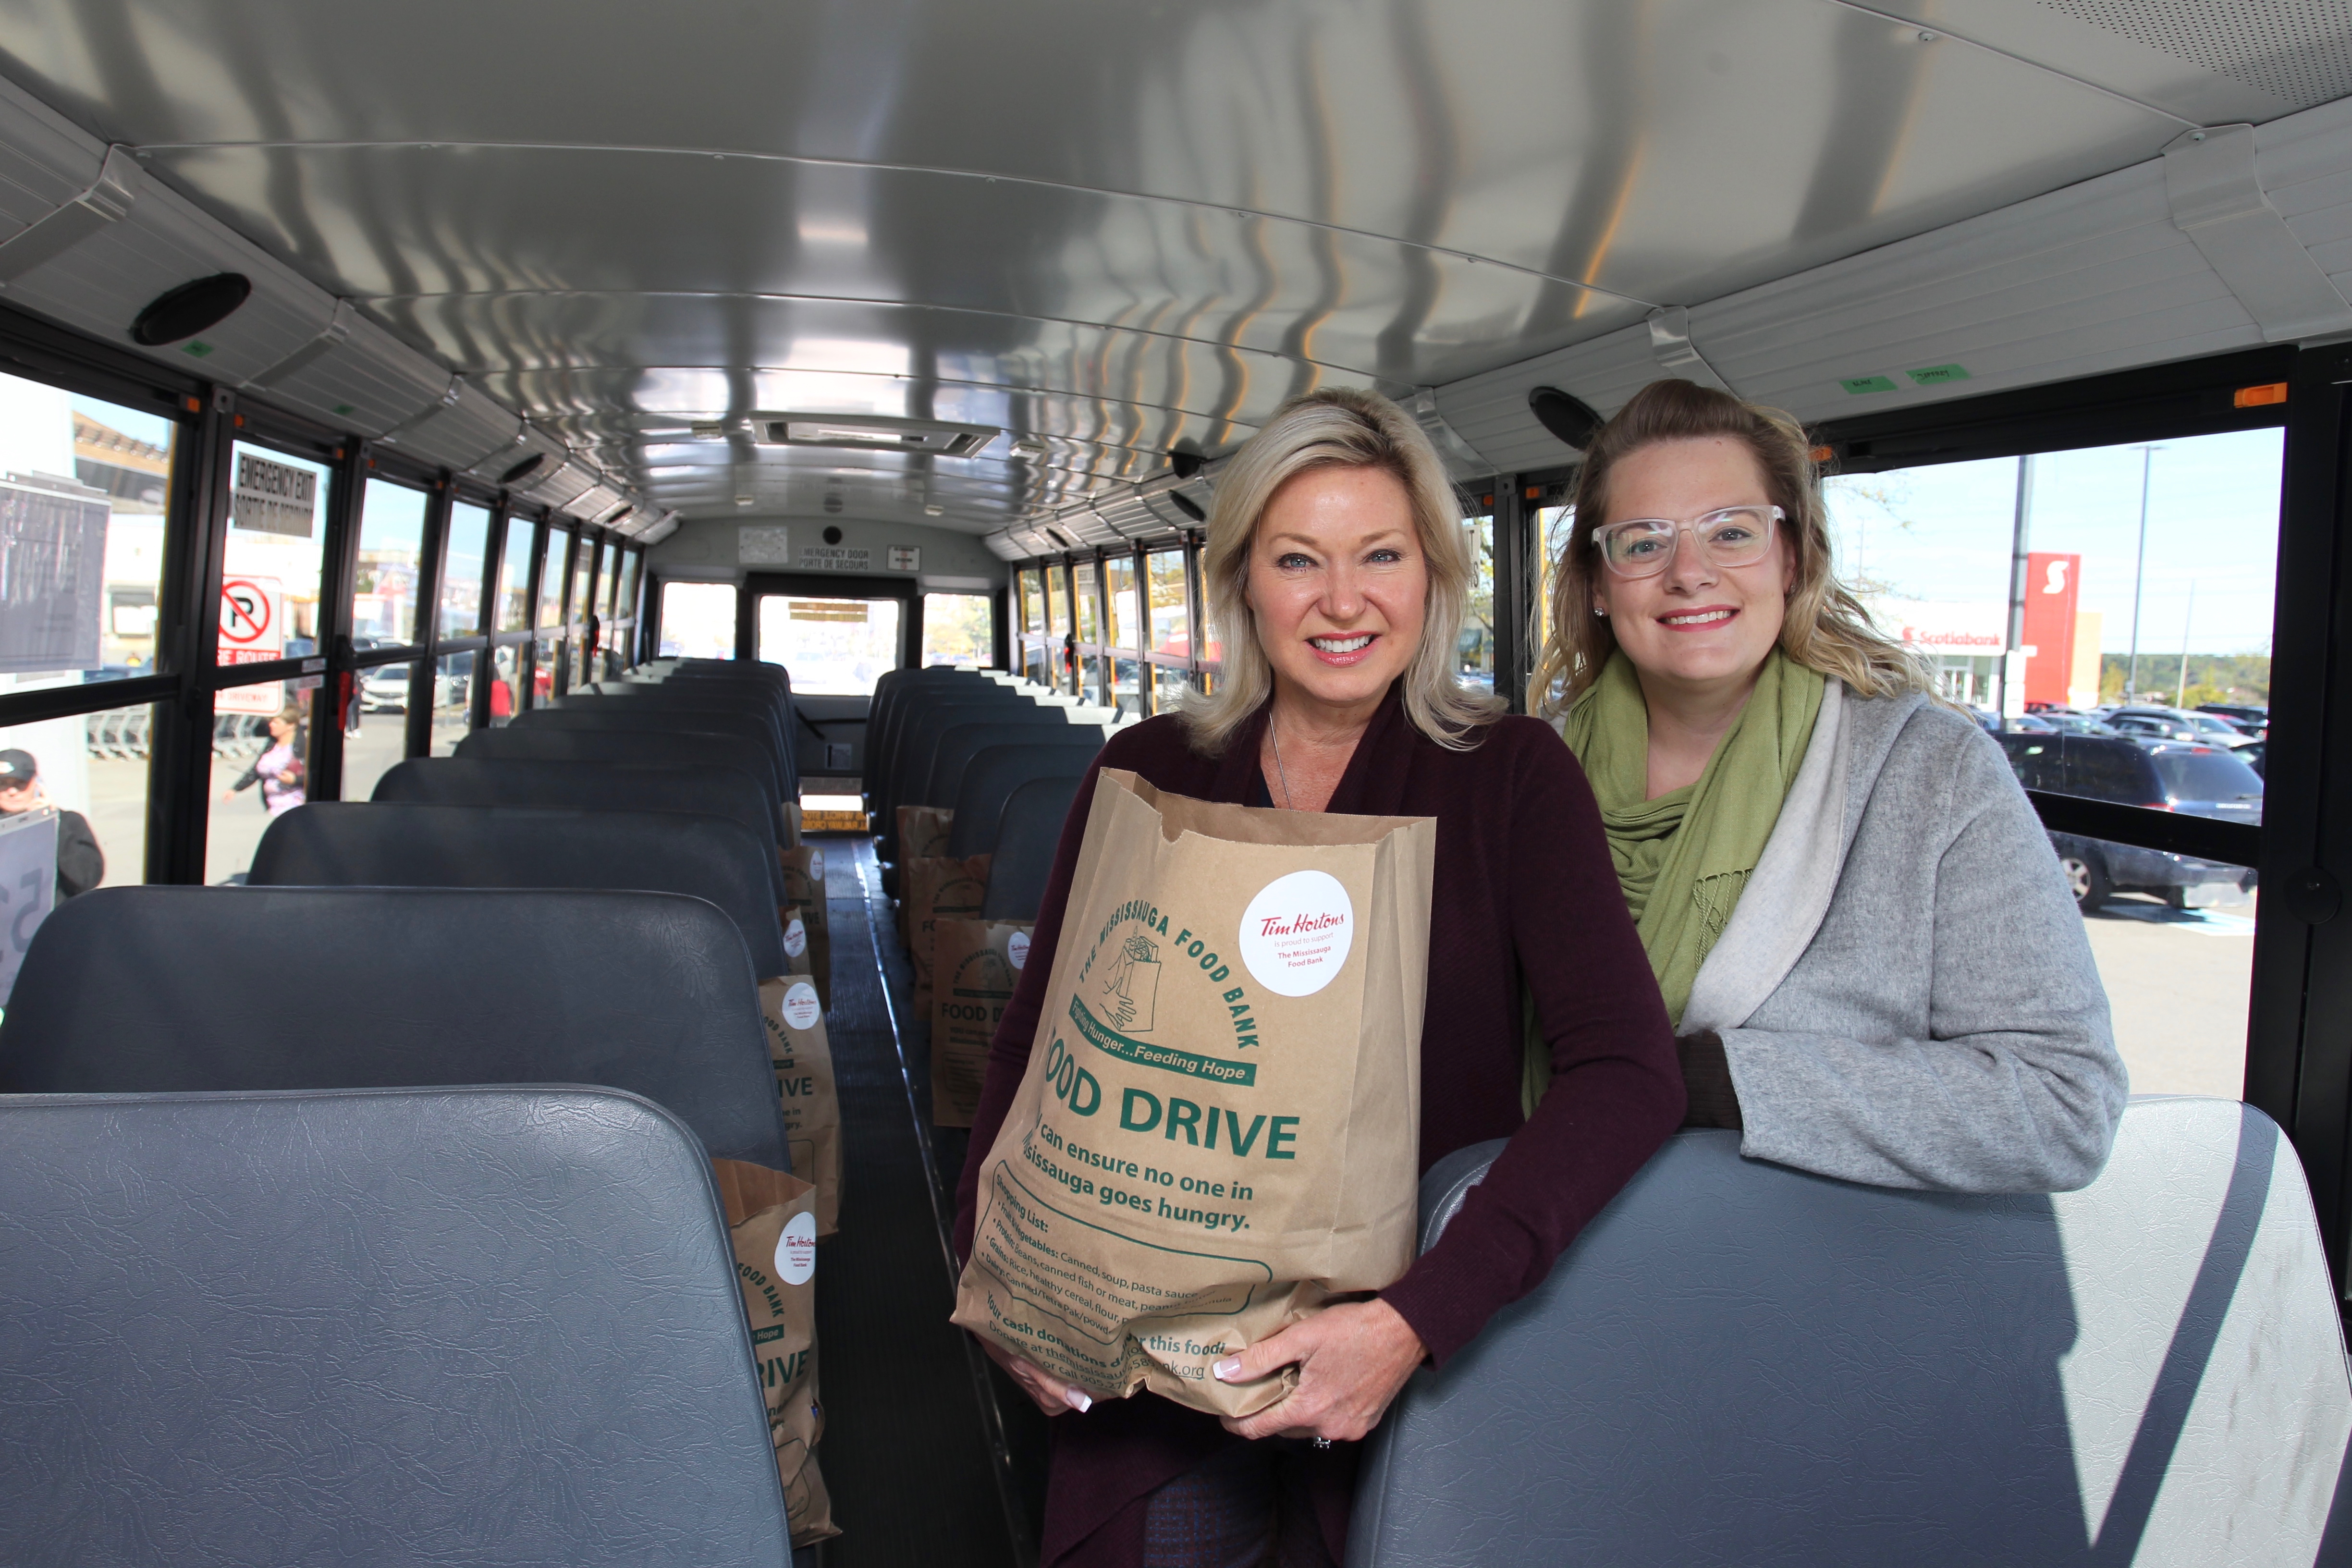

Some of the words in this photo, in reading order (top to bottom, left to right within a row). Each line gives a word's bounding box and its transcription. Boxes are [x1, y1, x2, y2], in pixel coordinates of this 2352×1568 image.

[239, 455, 295, 497] EMERGENCY
[295, 471, 314, 501] EXIT
[799, 547, 845, 558] EMERGENCY
[847, 549, 868, 559] DOOR
[799, 558, 821, 568] PORTE
[824, 559, 833, 569] DE
[835, 559, 868, 570] SECOURS
[1920, 630, 2000, 646] Scotiabank
[1261, 917, 1290, 937] Tim
[1293, 912, 1344, 934] Hortons
[1281, 938, 1302, 948] proud
[1311, 932, 1334, 943] support
[1293, 945, 1332, 958] Mississauga
[1307, 956, 1323, 965] Bank
[1079, 944, 1097, 984] THE
[1100, 899, 1169, 947] MISSISSAUGA
[1174, 928, 1230, 982] FOOD
[1223, 987, 1259, 1050] BANK
[942, 1002, 988, 1022] FOOD
[764, 1016, 779, 1031] OOD
[778, 1031, 793, 1054] BANK
[1072, 1000, 1088, 1031] Fighting
[1201, 1060, 1246, 1080] Hope
[778, 1077, 813, 1098] IVE
[1045, 1028, 1102, 1117] OOD
[1119, 1087, 1300, 1160] DRIVE
[784, 1122, 803, 1131] gry.
[1041, 1124, 1063, 1152] can
[1067, 1142, 1139, 1178] ensure
[1144, 1157, 1174, 1187] no
[1180, 1176, 1225, 1198] one
[1231, 1181, 1253, 1201] in
[1022, 1129, 1094, 1195] sissauga
[1099, 1186, 1152, 1213] goes
[1157, 1196, 1250, 1233] hungry.
[997, 1174, 1026, 1220] Shopping
[1027, 1209, 1049, 1233] List:
[786, 1236, 796, 1248] Tim
[796, 1235, 816, 1248] Horton
[996, 1219, 1015, 1249] Protein:
[1015, 1243, 1039, 1267] Beans,
[1040, 1263, 1076, 1282] canned
[1078, 1275, 1094, 1292] fish
[1096, 1287, 1107, 1298] or
[1108, 1293, 1138, 1311] meat,
[1015, 1222, 1058, 1259] Vegetables:
[1061, 1252, 1101, 1277] Canned,
[1102, 1271, 1129, 1289] soup,
[1131, 1281, 1163, 1297] pasta
[986, 1252, 1005, 1277] Dairy:
[1005, 1272, 1063, 1309] Canned/Tetra
[990, 1237, 1009, 1264] Grains:
[1009, 1258, 1029, 1277] Rice,
[1029, 1269, 1063, 1295] healthy
[1065, 1289, 1094, 1312] cereal,
[1095, 1303, 1120, 1323] flour,
[763, 1285, 785, 1318] BANK
[757, 1328, 779, 1340] Hope
[987, 1289, 1002, 1320] Your
[1003, 1317, 1033, 1336] cash
[1037, 1328, 1107, 1368] donations
[1149, 1335, 1181, 1352] this
[1184, 1339, 1226, 1356] food!
[989, 1320, 1028, 1348] Donate
[1031, 1344, 1043, 1354] at
[758, 1349, 809, 1389] RIVE
[1042, 1361, 1056, 1369] or
[1059, 1366, 1078, 1380] call
